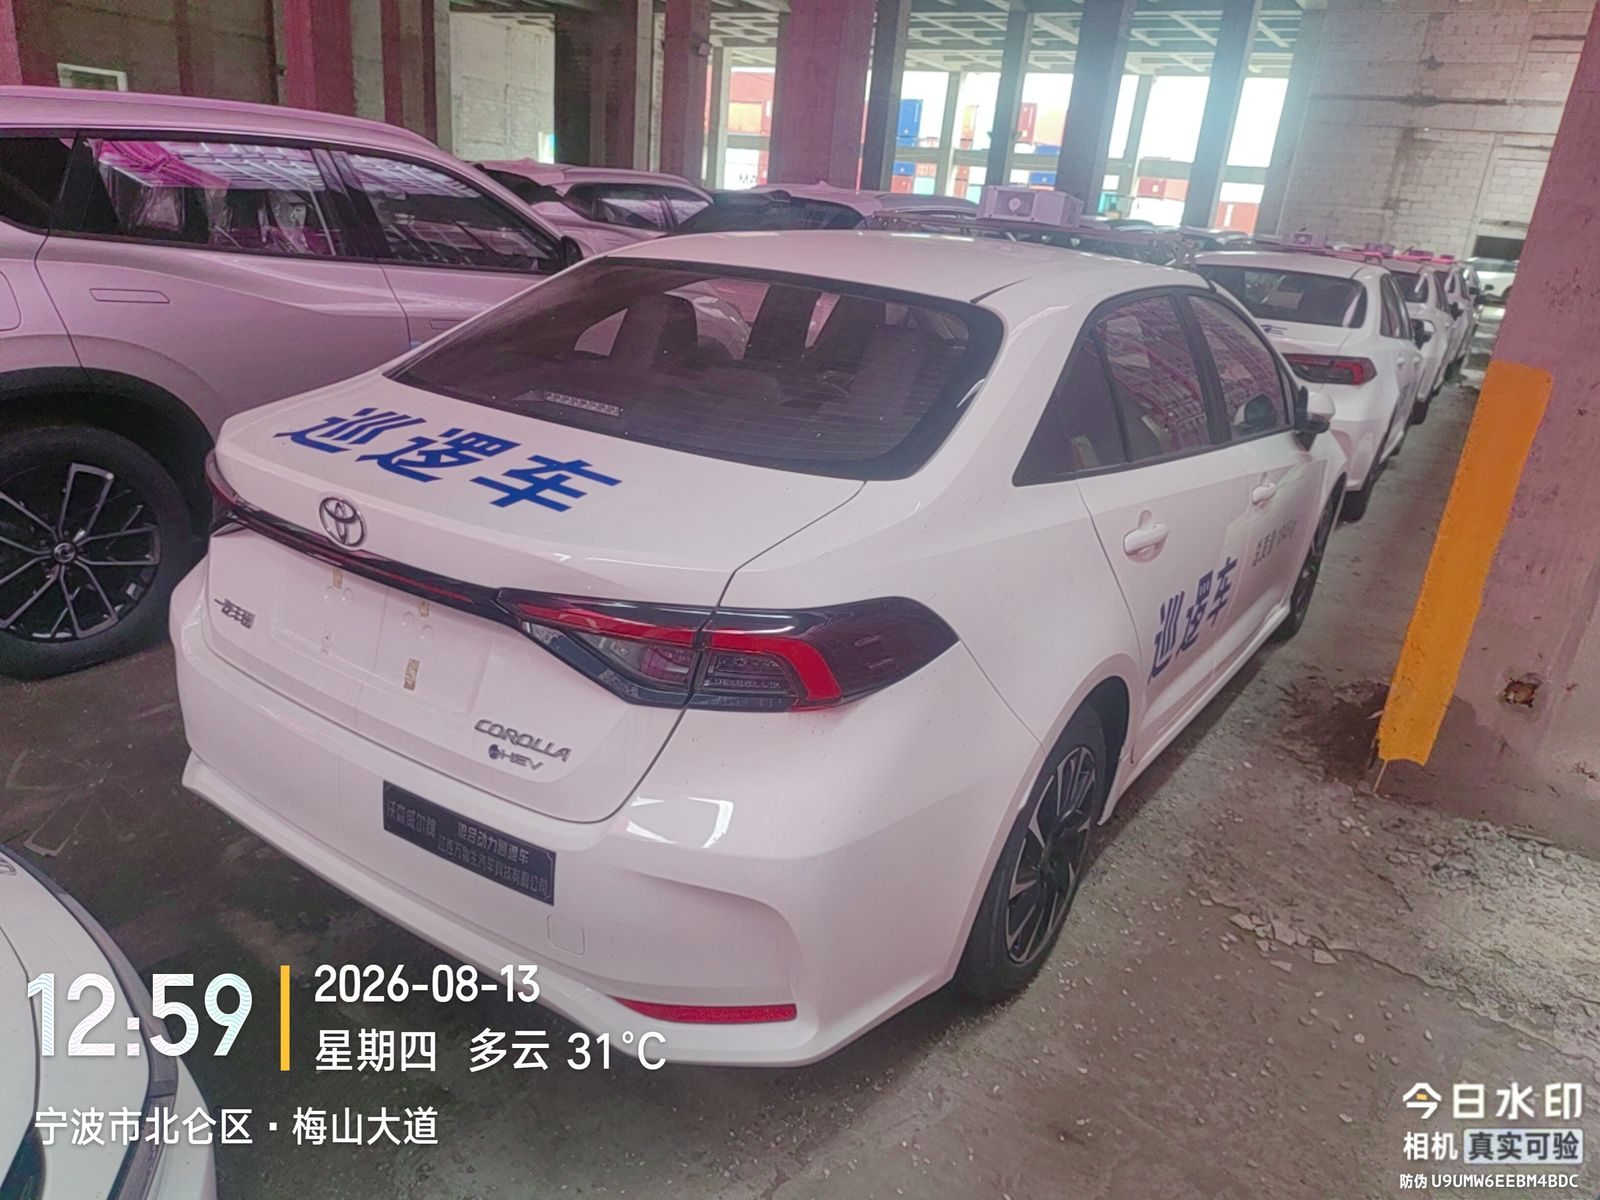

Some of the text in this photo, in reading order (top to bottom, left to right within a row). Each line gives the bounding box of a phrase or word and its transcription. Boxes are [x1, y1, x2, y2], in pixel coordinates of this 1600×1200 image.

[273, 407, 622, 512] 巡逻车
[1147, 557, 1239, 686] 巡逻车
[474, 719, 572, 762] COROLLA
